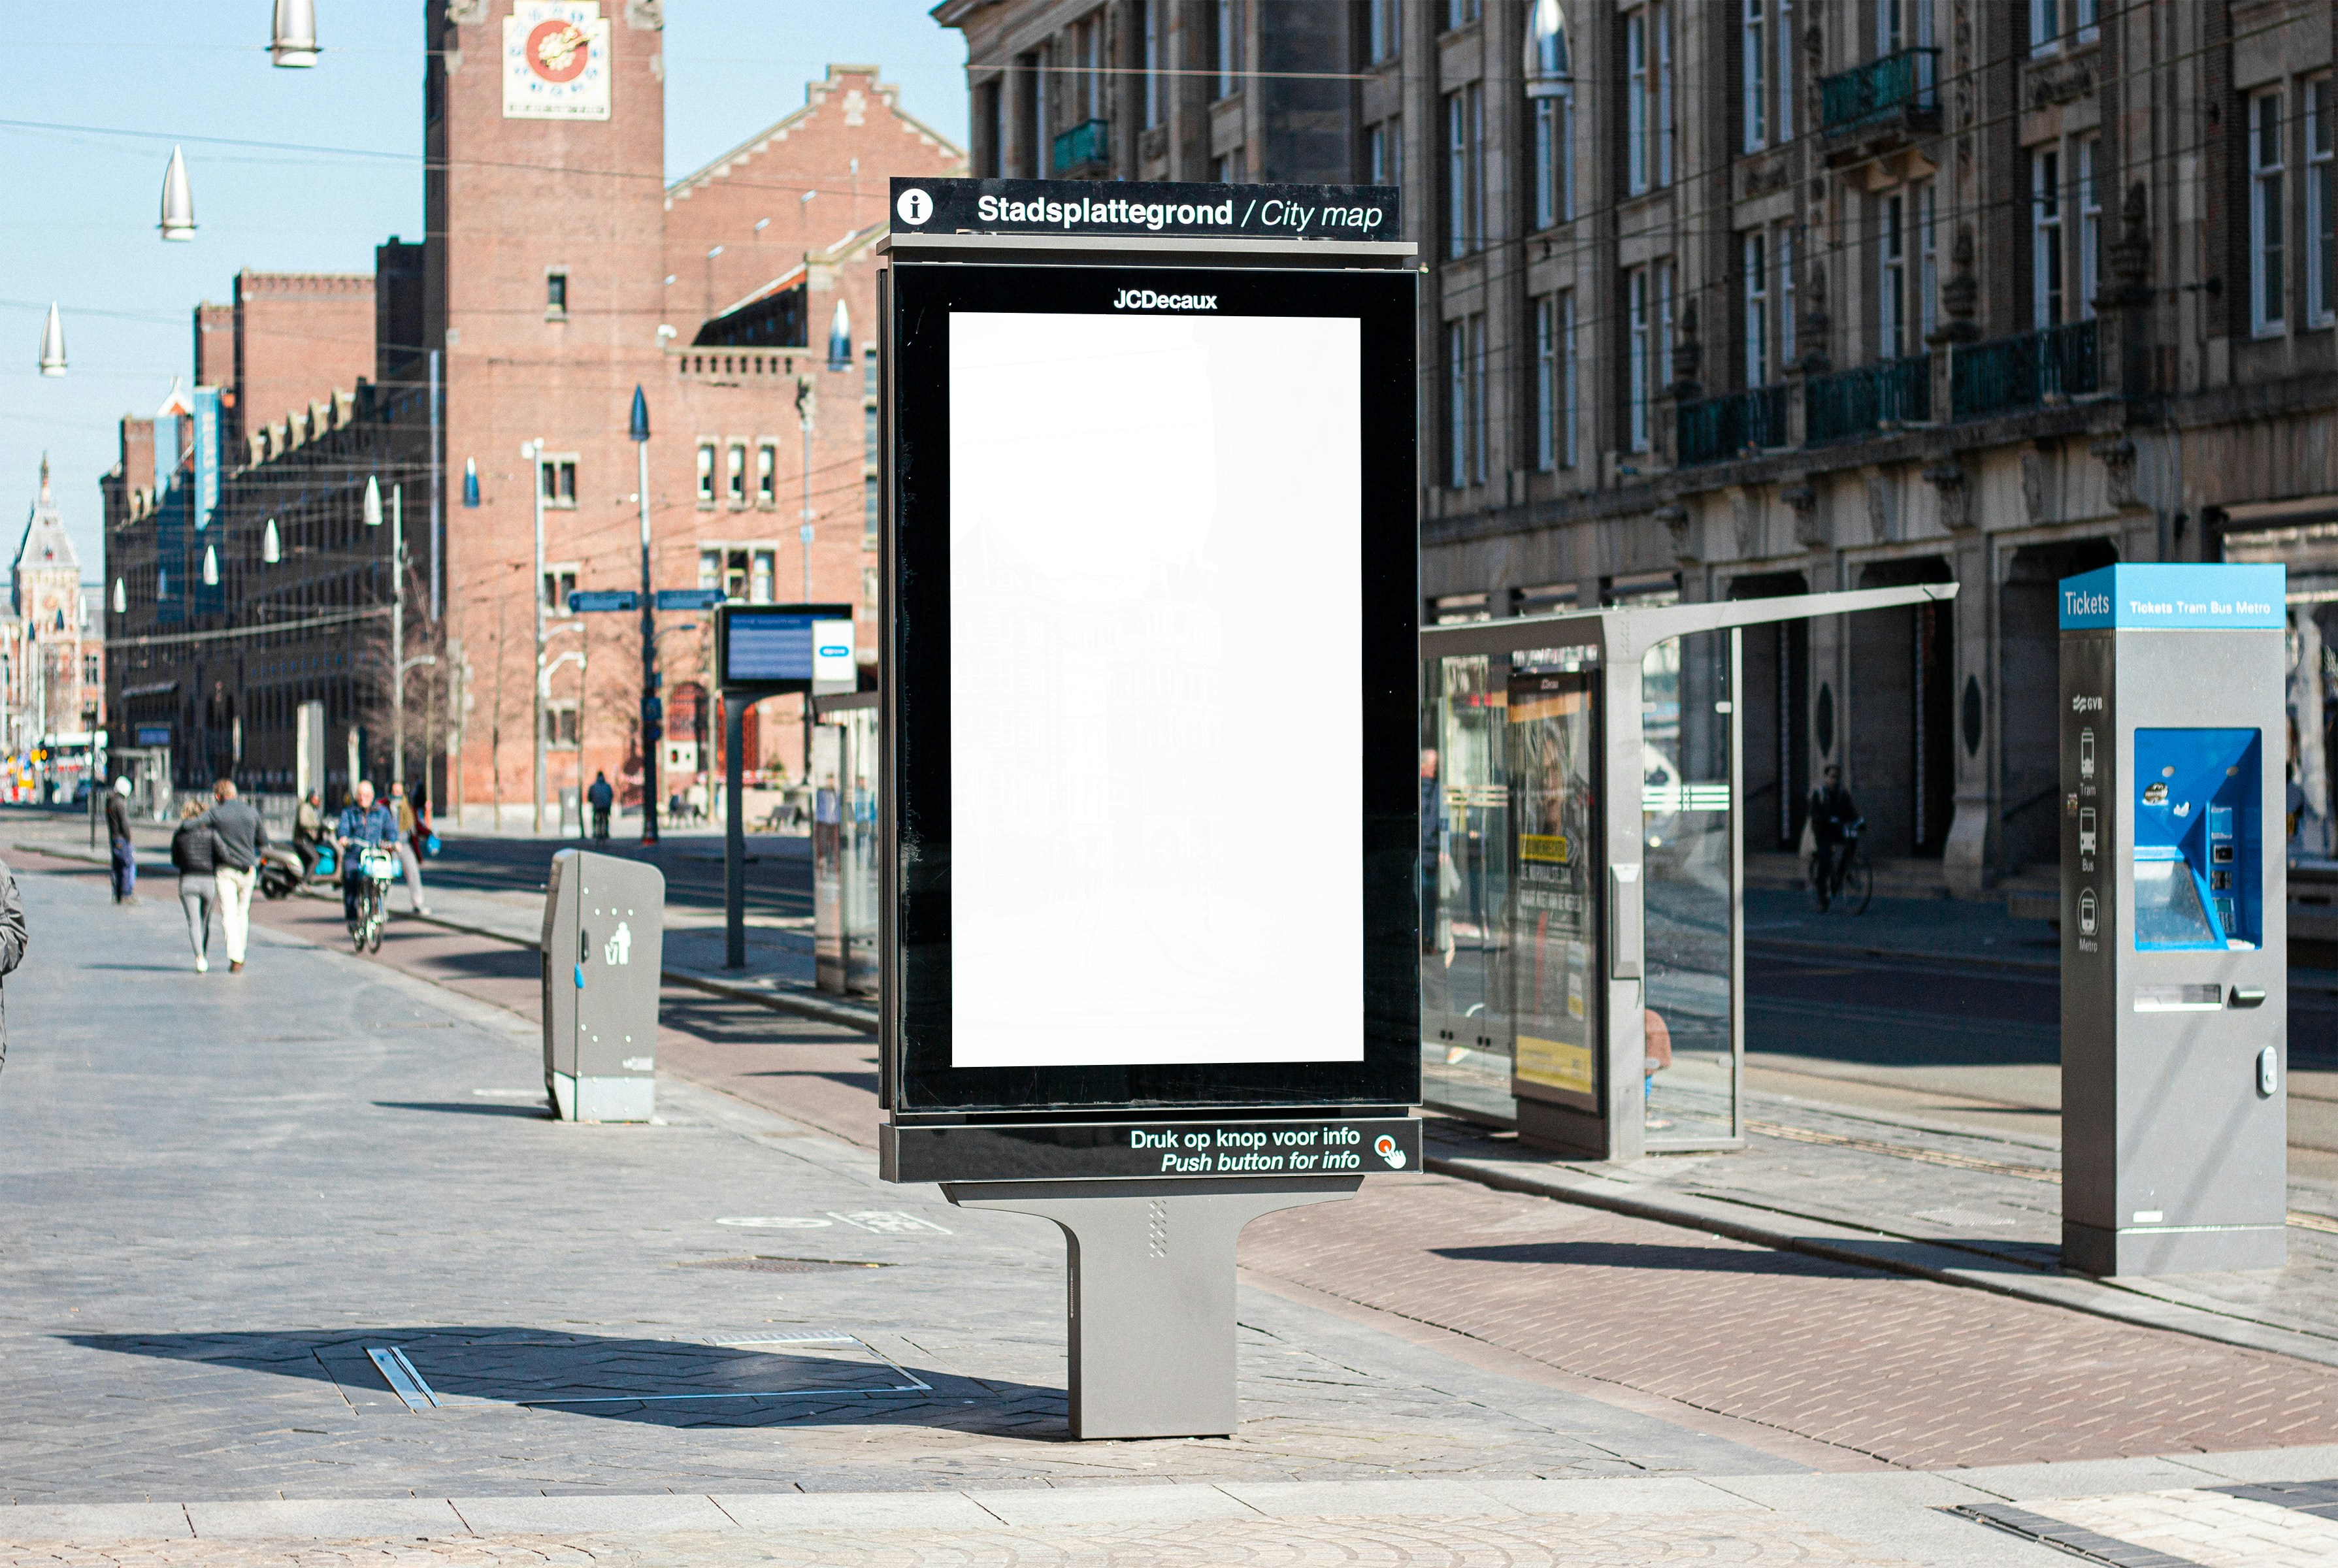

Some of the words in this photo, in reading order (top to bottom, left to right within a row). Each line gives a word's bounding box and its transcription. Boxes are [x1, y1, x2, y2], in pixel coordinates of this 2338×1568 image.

[978, 195, 1232, 230] Stadsplattegrond
[1240, 200, 1257, 227] /
[1261, 199, 1315, 231] City
[1321, 207, 1383, 233] map
[1113, 290, 1218, 310] JCDecaux
[2065, 591, 2110, 615] Tickets
[2130, 600, 2173, 615] Tickets
[2176, 600, 2207, 615] Tram
[2211, 600, 2232, 615] Bus
[2236, 600, 2271, 615] Metro
[2087, 696, 2103, 711] GVB
[2080, 783, 2096, 796] Tram
[2082, 858, 2094, 872] Bus
[2079, 938, 2098, 953] Metro
[1131, 1130, 1178, 1149] Druk
[1184, 1134, 1211, 1151] op
[1217, 1129, 1266, 1151] knop
[1272, 1132, 1318, 1146] voor
[1323, 1127, 1360, 1145] info
[1161, 1152, 1212, 1172] Push
[1217, 1151, 1283, 1171] button
[1289, 1151, 1319, 1170] for
[1321, 1151, 1360, 1169] info
